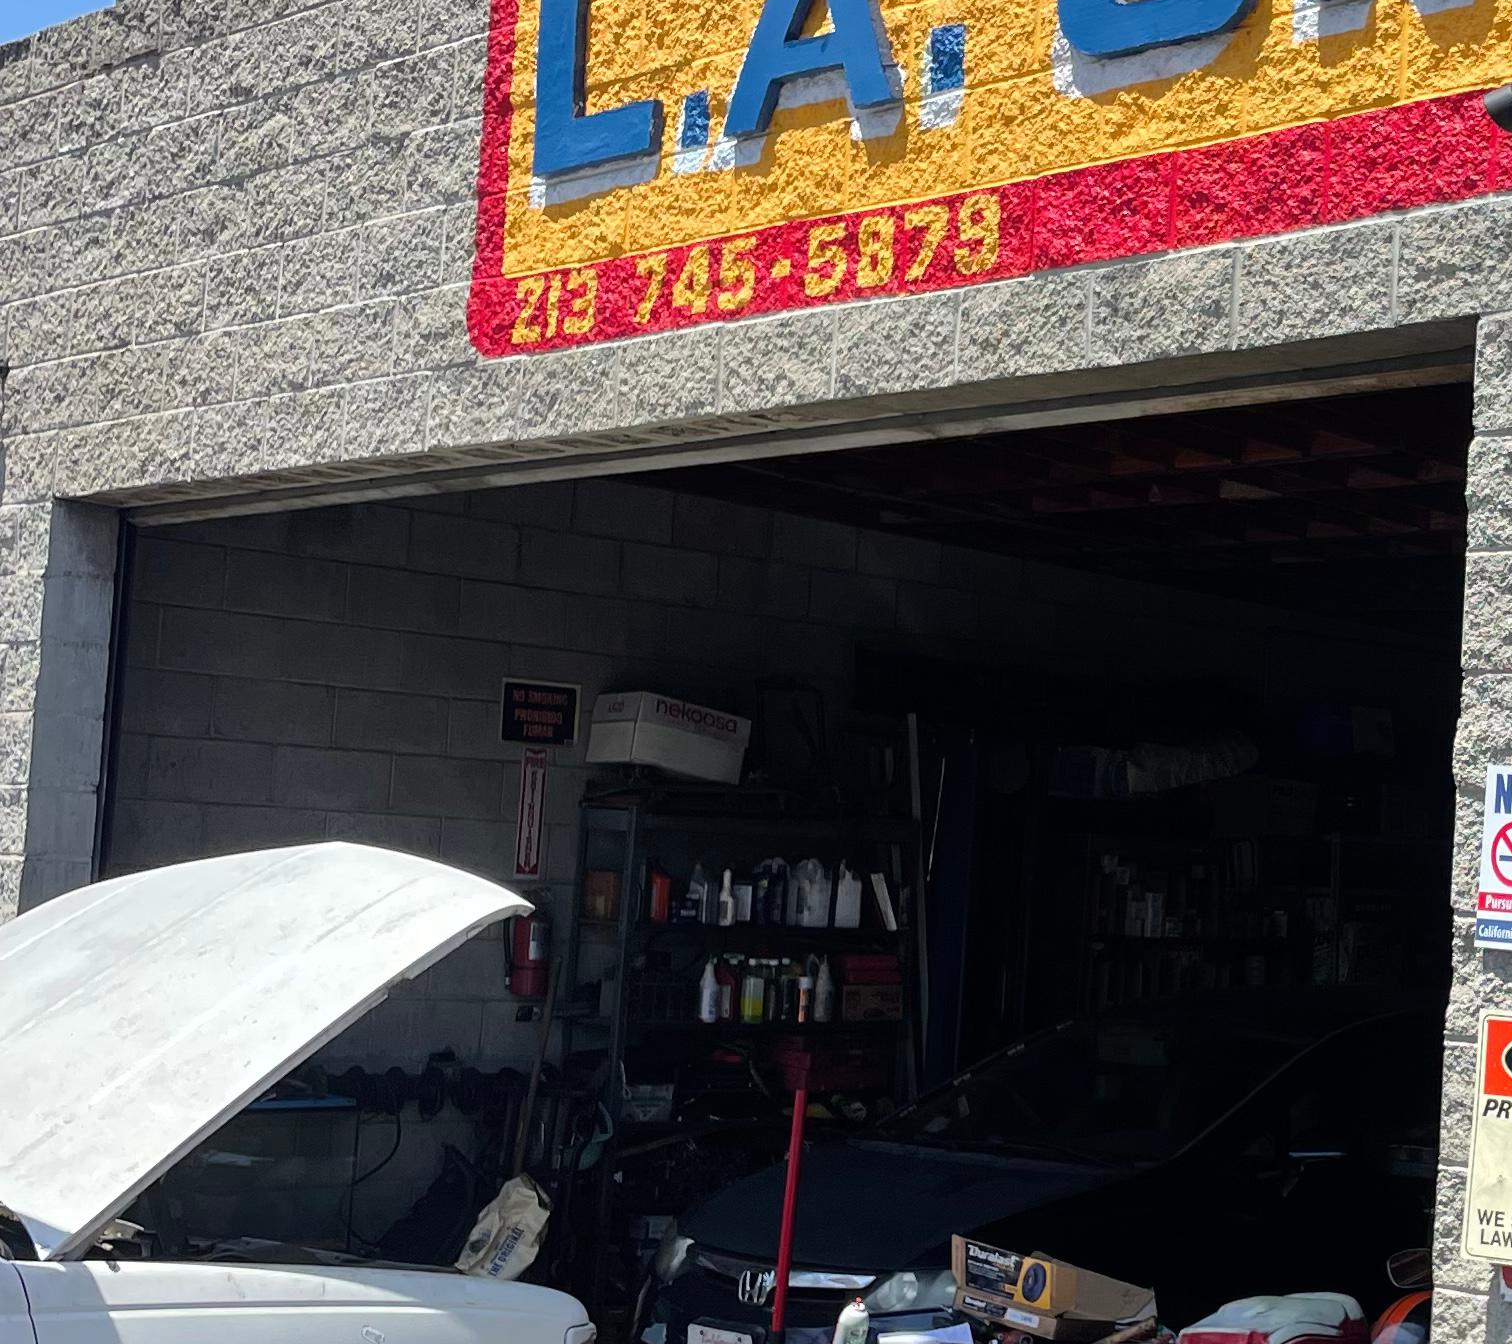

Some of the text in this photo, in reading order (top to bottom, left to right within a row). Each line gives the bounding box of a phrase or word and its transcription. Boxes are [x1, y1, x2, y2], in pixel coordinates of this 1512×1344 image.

[511, 269, 599, 344] 213
[656, 699, 737, 733] nekoosa
[1477, 1208, 1505, 1228] WE
